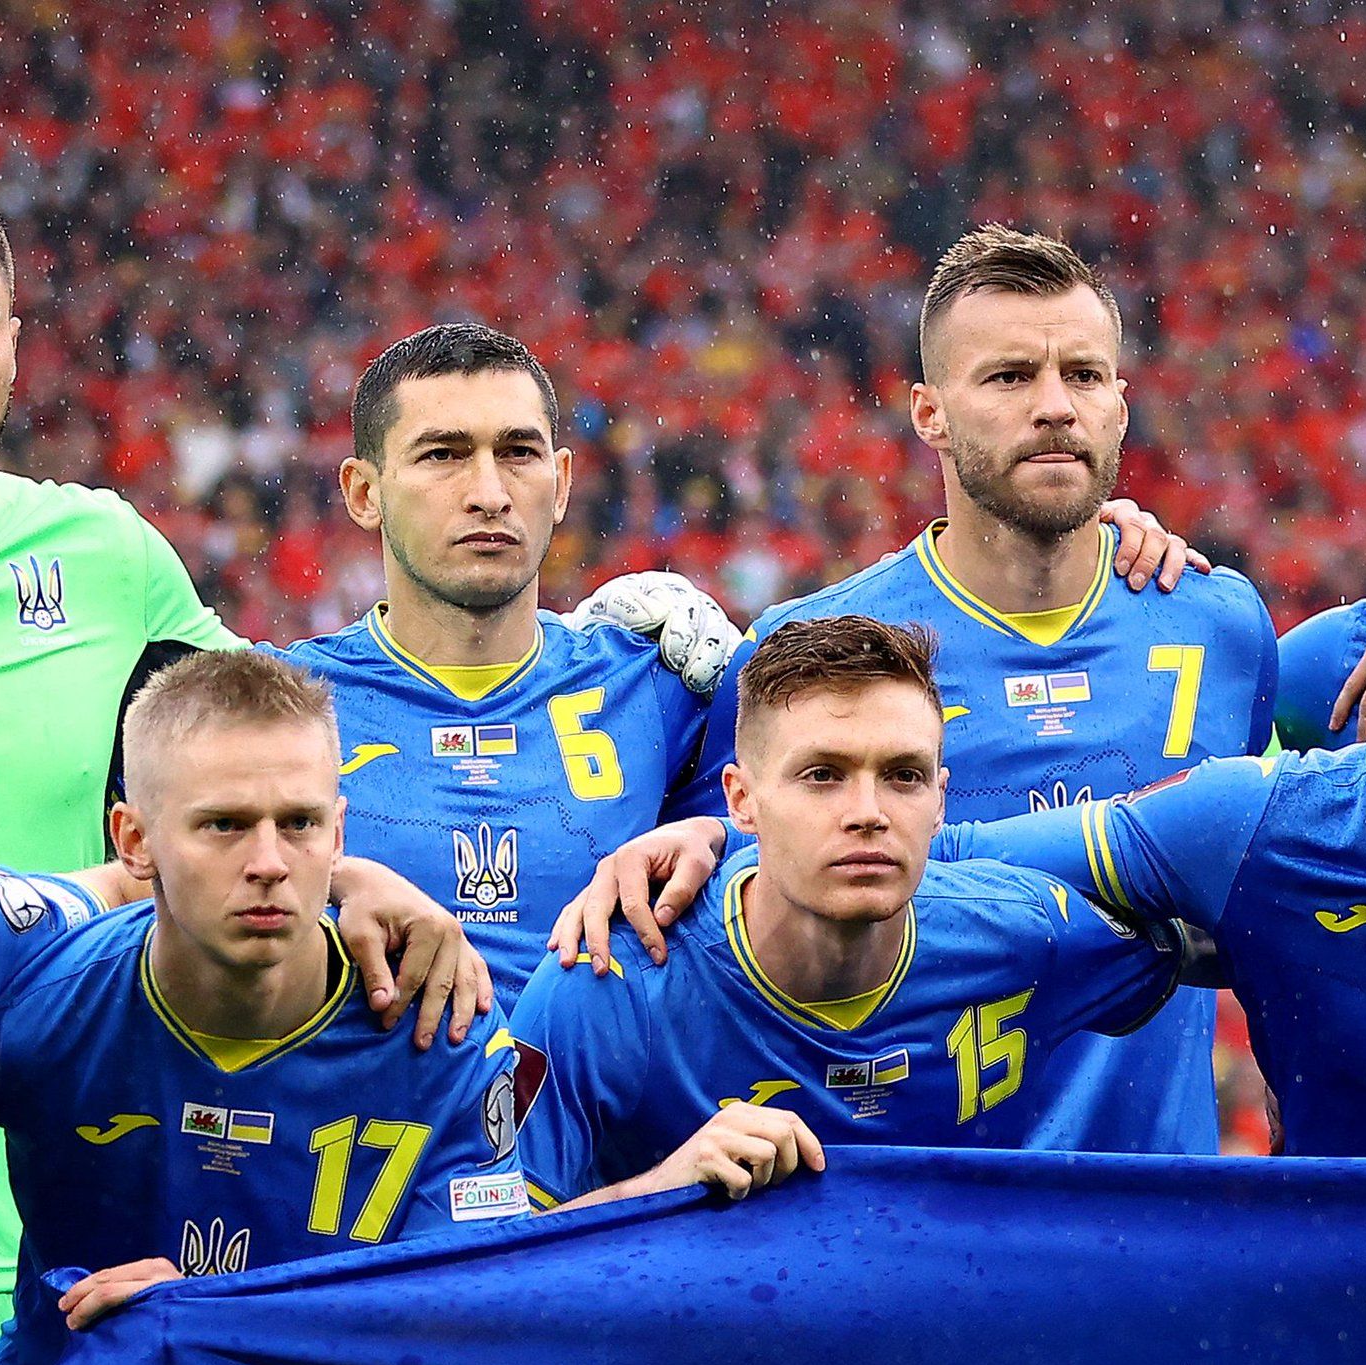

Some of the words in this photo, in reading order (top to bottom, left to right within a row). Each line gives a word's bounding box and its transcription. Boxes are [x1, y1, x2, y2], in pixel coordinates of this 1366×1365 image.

[546, 686, 624, 801] 6
[1147, 644, 1205, 759] 7
[456, 910, 518, 923] UKRAINE
[946, 988, 1034, 1126] 15
[308, 1114, 432, 1244] 17
[453, 1180, 478, 1191] UEFA
